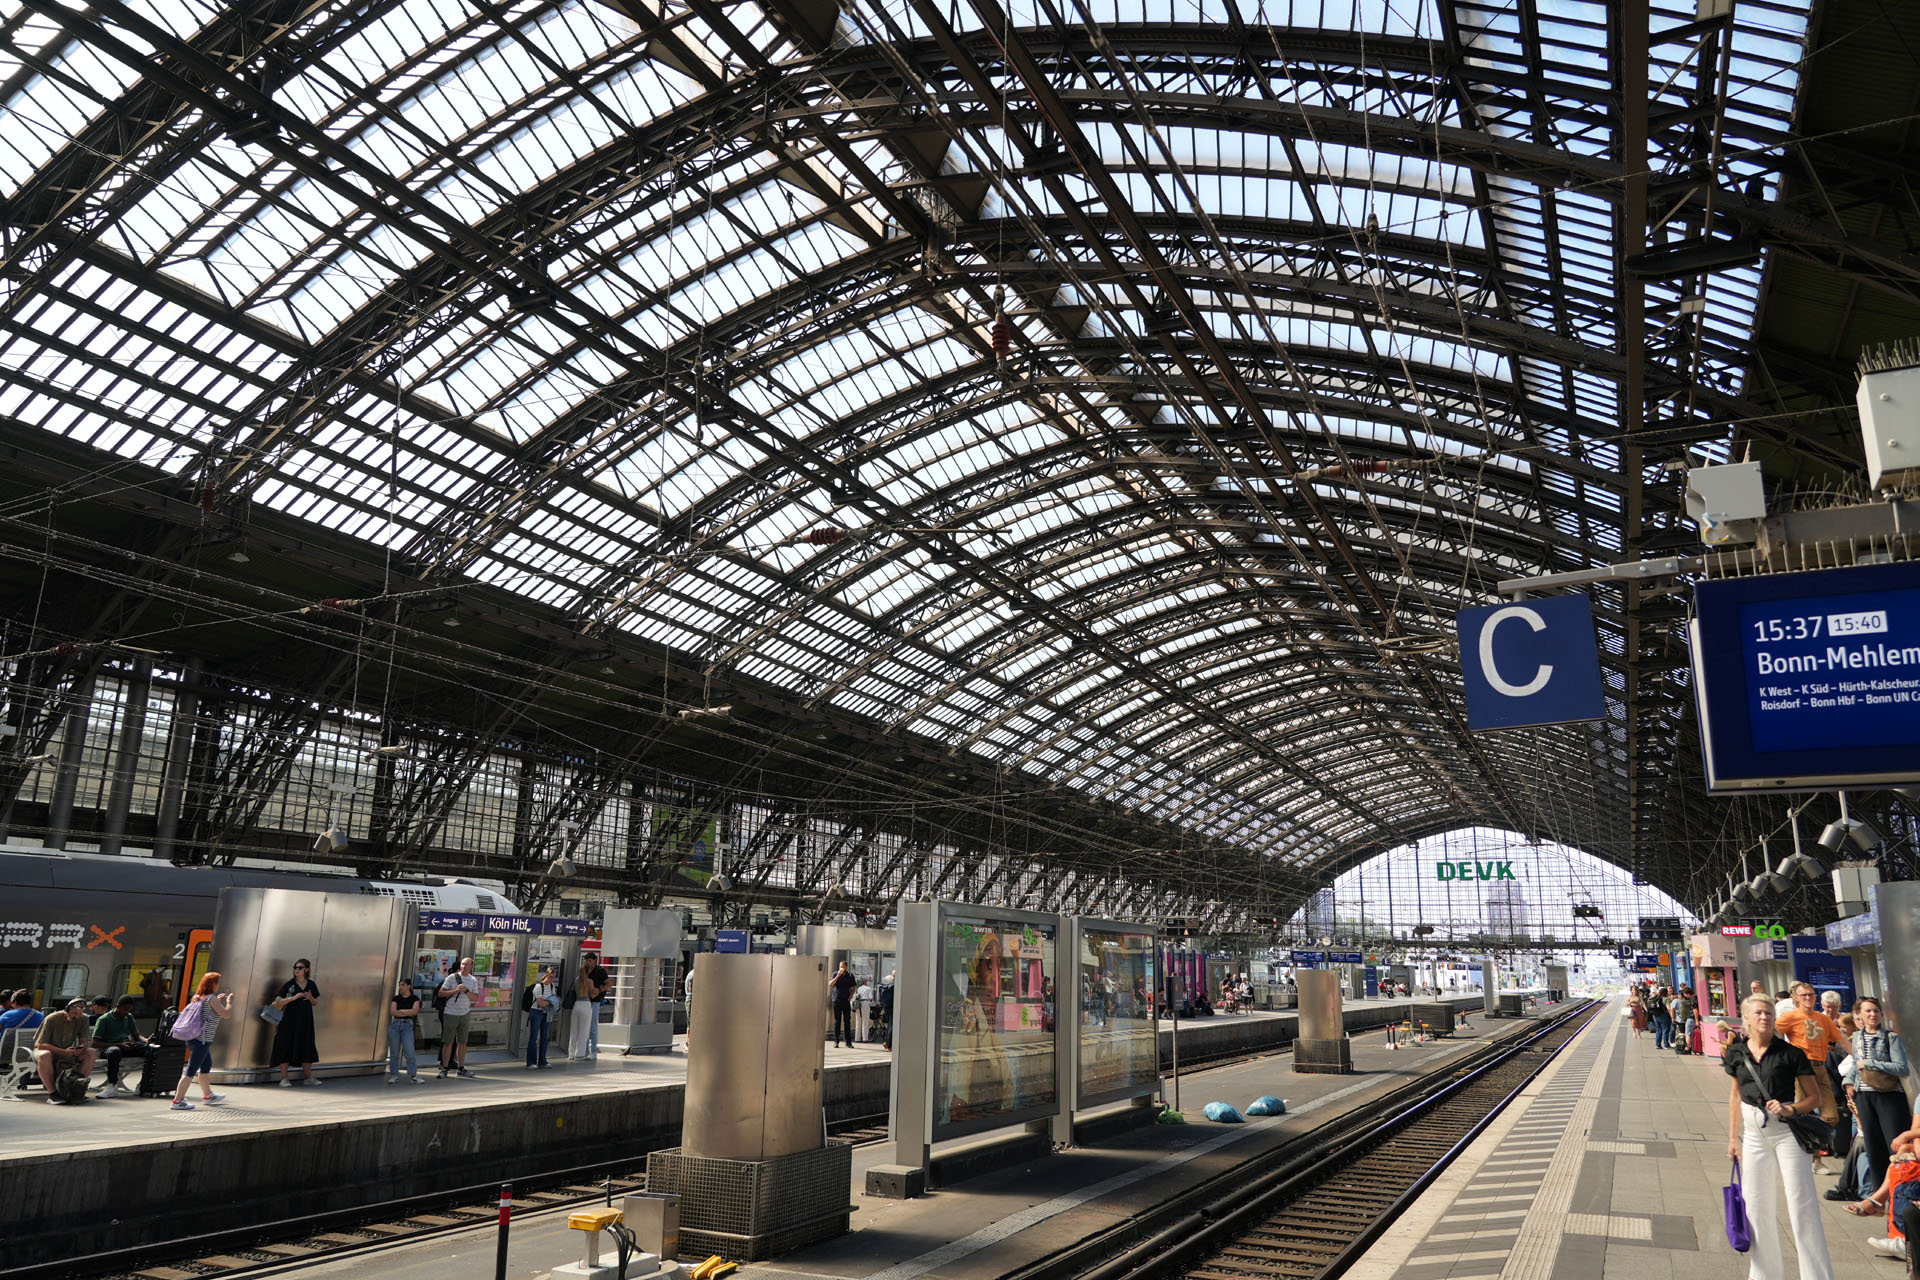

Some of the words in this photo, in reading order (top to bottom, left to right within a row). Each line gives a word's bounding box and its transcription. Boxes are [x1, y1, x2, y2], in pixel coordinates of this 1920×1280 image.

[1753, 615, 1823, 642] 15:37
[1833, 615, 1882, 632] 15:40
[1479, 606, 1553, 697] C
[1757, 643, 1920, 675] Bonn-Mehlem
[1759, 687, 1767, 697] K
[1768, 686, 1792, 697] West
[1801, 684, 1809, 695] K
[1810, 683, 1829, 694] Süd
[1761, 698, 1801, 711] Roisdorf
[1810, 697, 1836, 708] Bonn
[1837, 694, 1856, 706] Hbf
[1865, 693, 1892, 705] Bonn
[1893, 691, 1910, 703] UN
[1436, 861, 1516, 880] DEVK
[489, 917, 510, 929] Köln
[512, 918, 528, 930] Hbf
[1722, 927, 1751, 935] REWE
[1755, 925, 1785, 939] GO
[173, 944, 185, 959] 2
[1623, 945, 1632, 956] D
